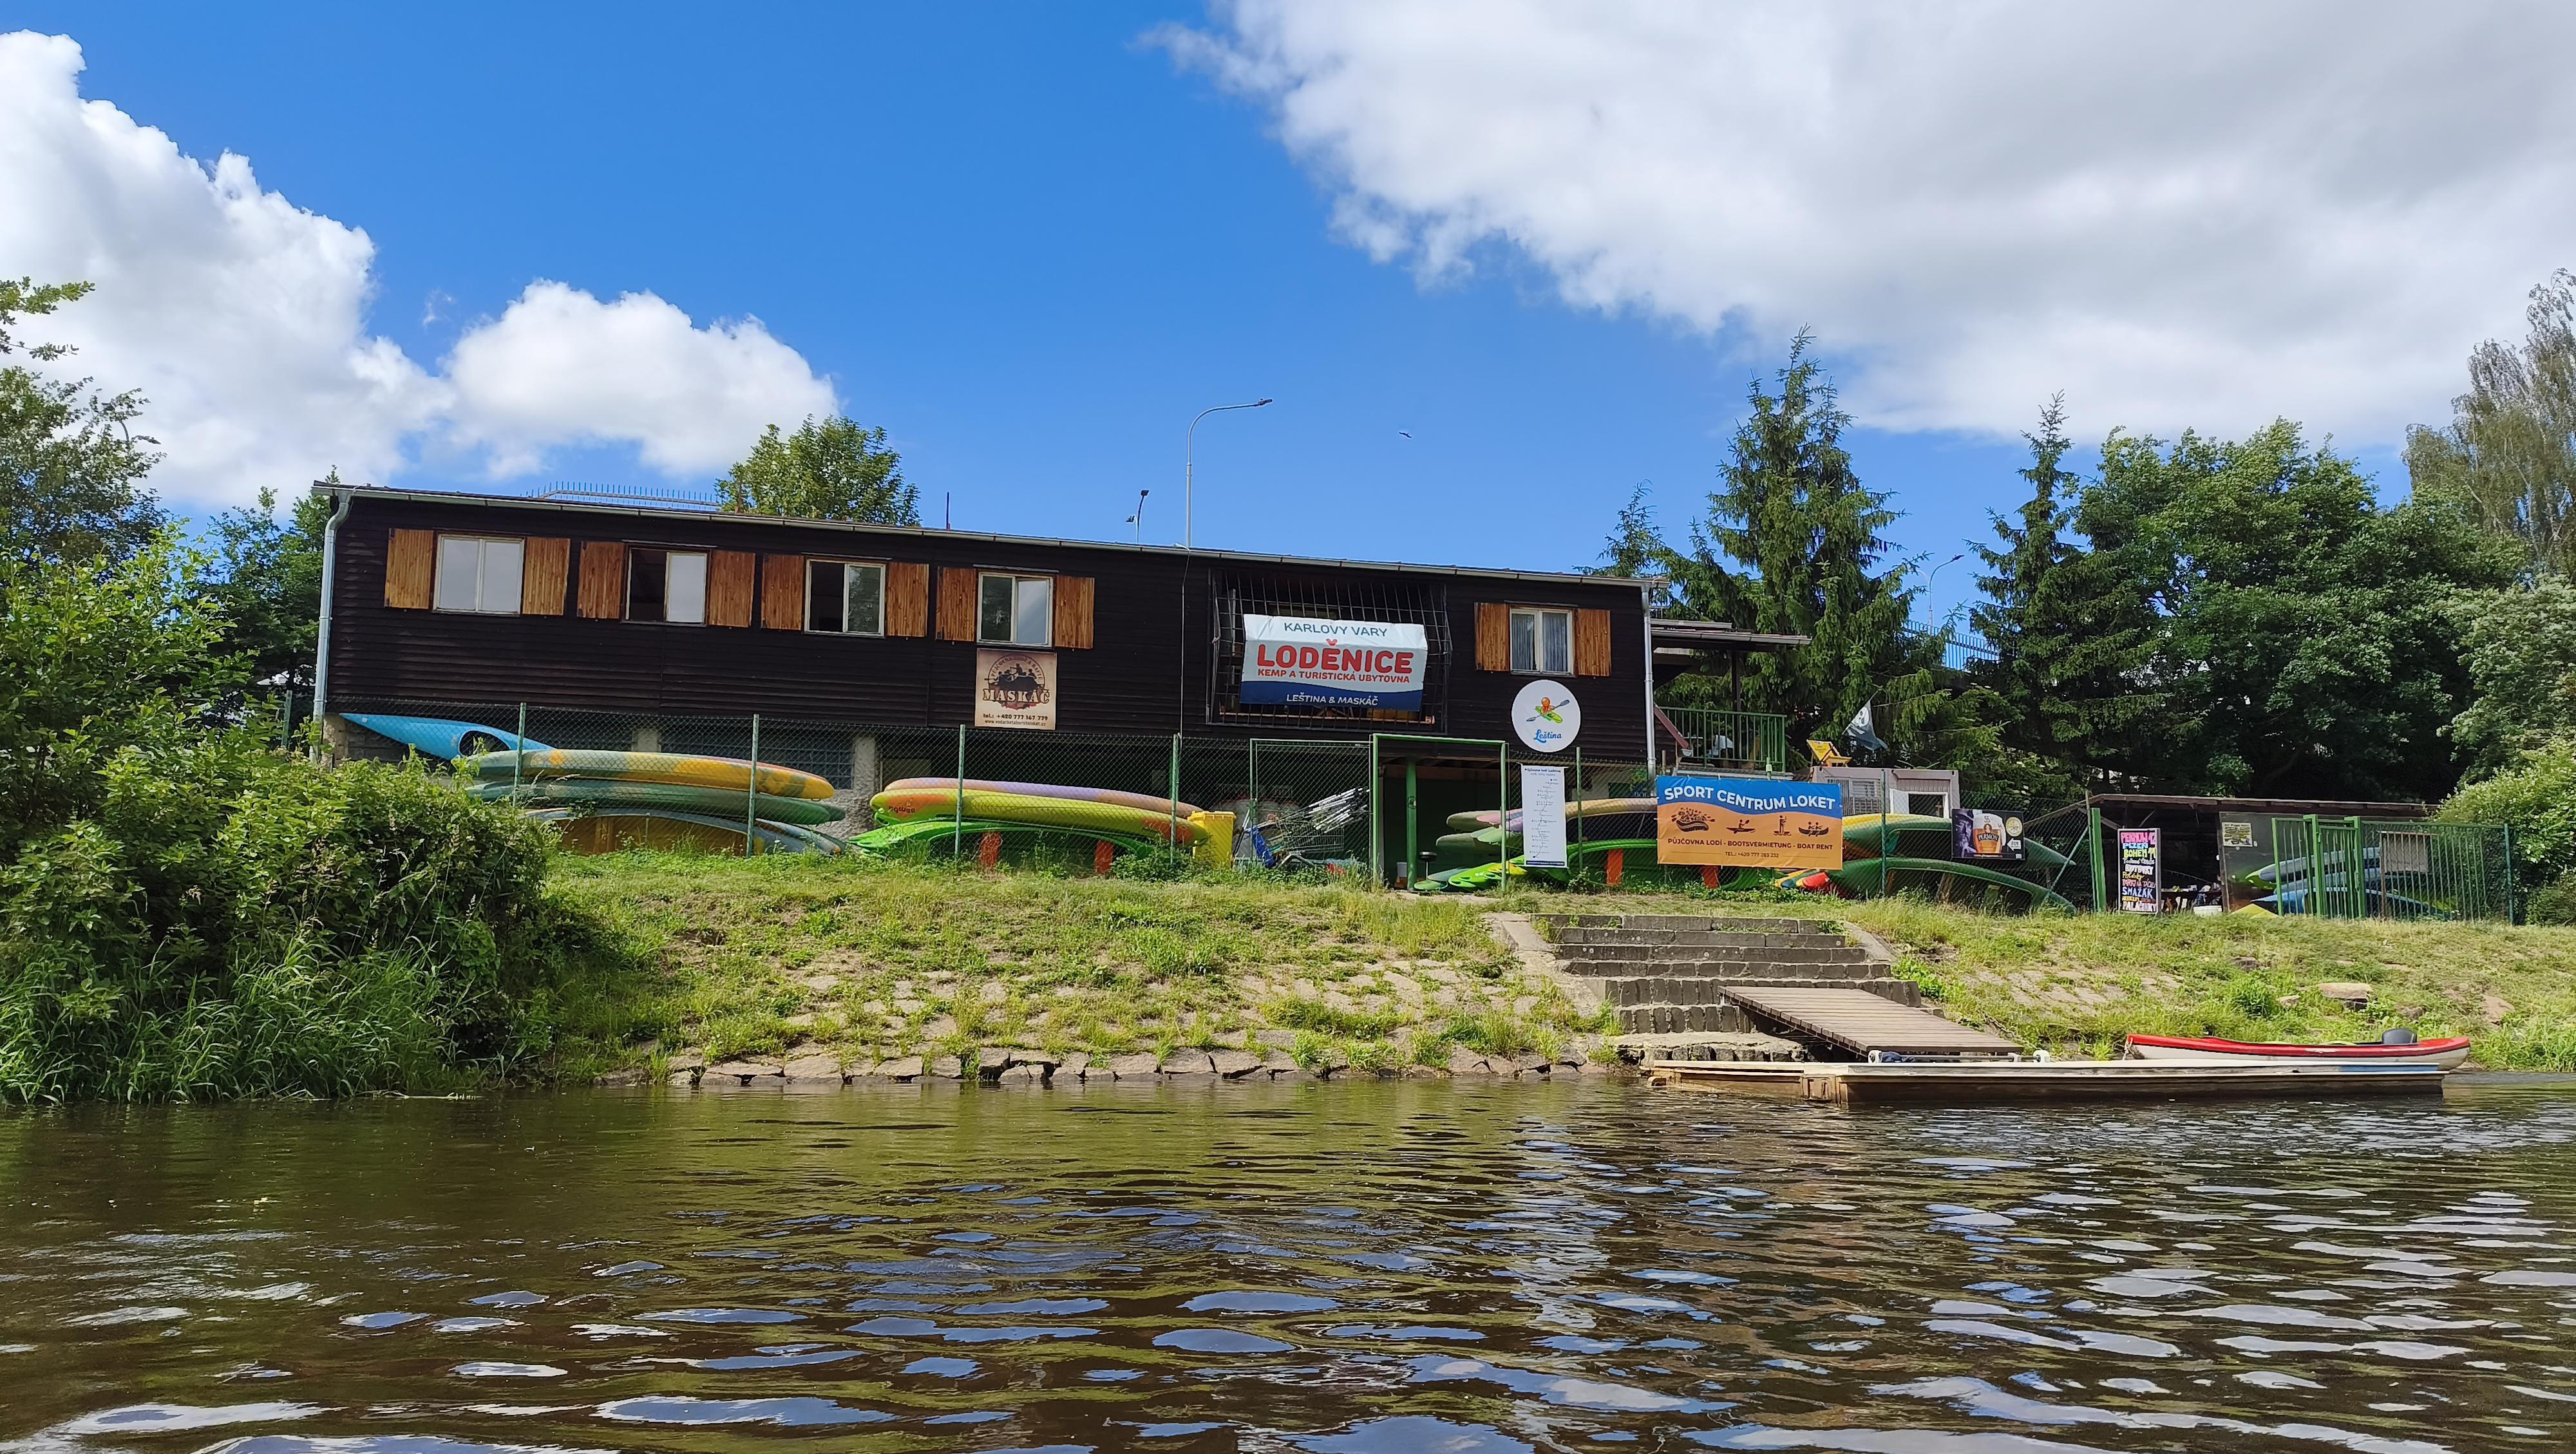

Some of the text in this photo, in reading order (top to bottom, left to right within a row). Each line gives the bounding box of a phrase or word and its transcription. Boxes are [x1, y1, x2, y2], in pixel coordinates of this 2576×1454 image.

[1283, 622, 1387, 637] KARLOVY VARY
[1257, 638, 1414, 674] LODĚNICE
[1258, 668, 1287, 677] KEMP
[1300, 670, 1355, 681] TURISTICKÁ
[1359, 674, 1410, 684] UBYTOVNA
[983, 688, 1050, 704] MASKÁČ
[1286, 692, 1379, 706] LEŠTINA & MASKÁČ
[1533, 729, 1562, 743] Leština
[1664, 785, 1835, 810] SPORT CENTRUM LOKET
[1668, 836, 1705, 845] PŮJČOVNA
